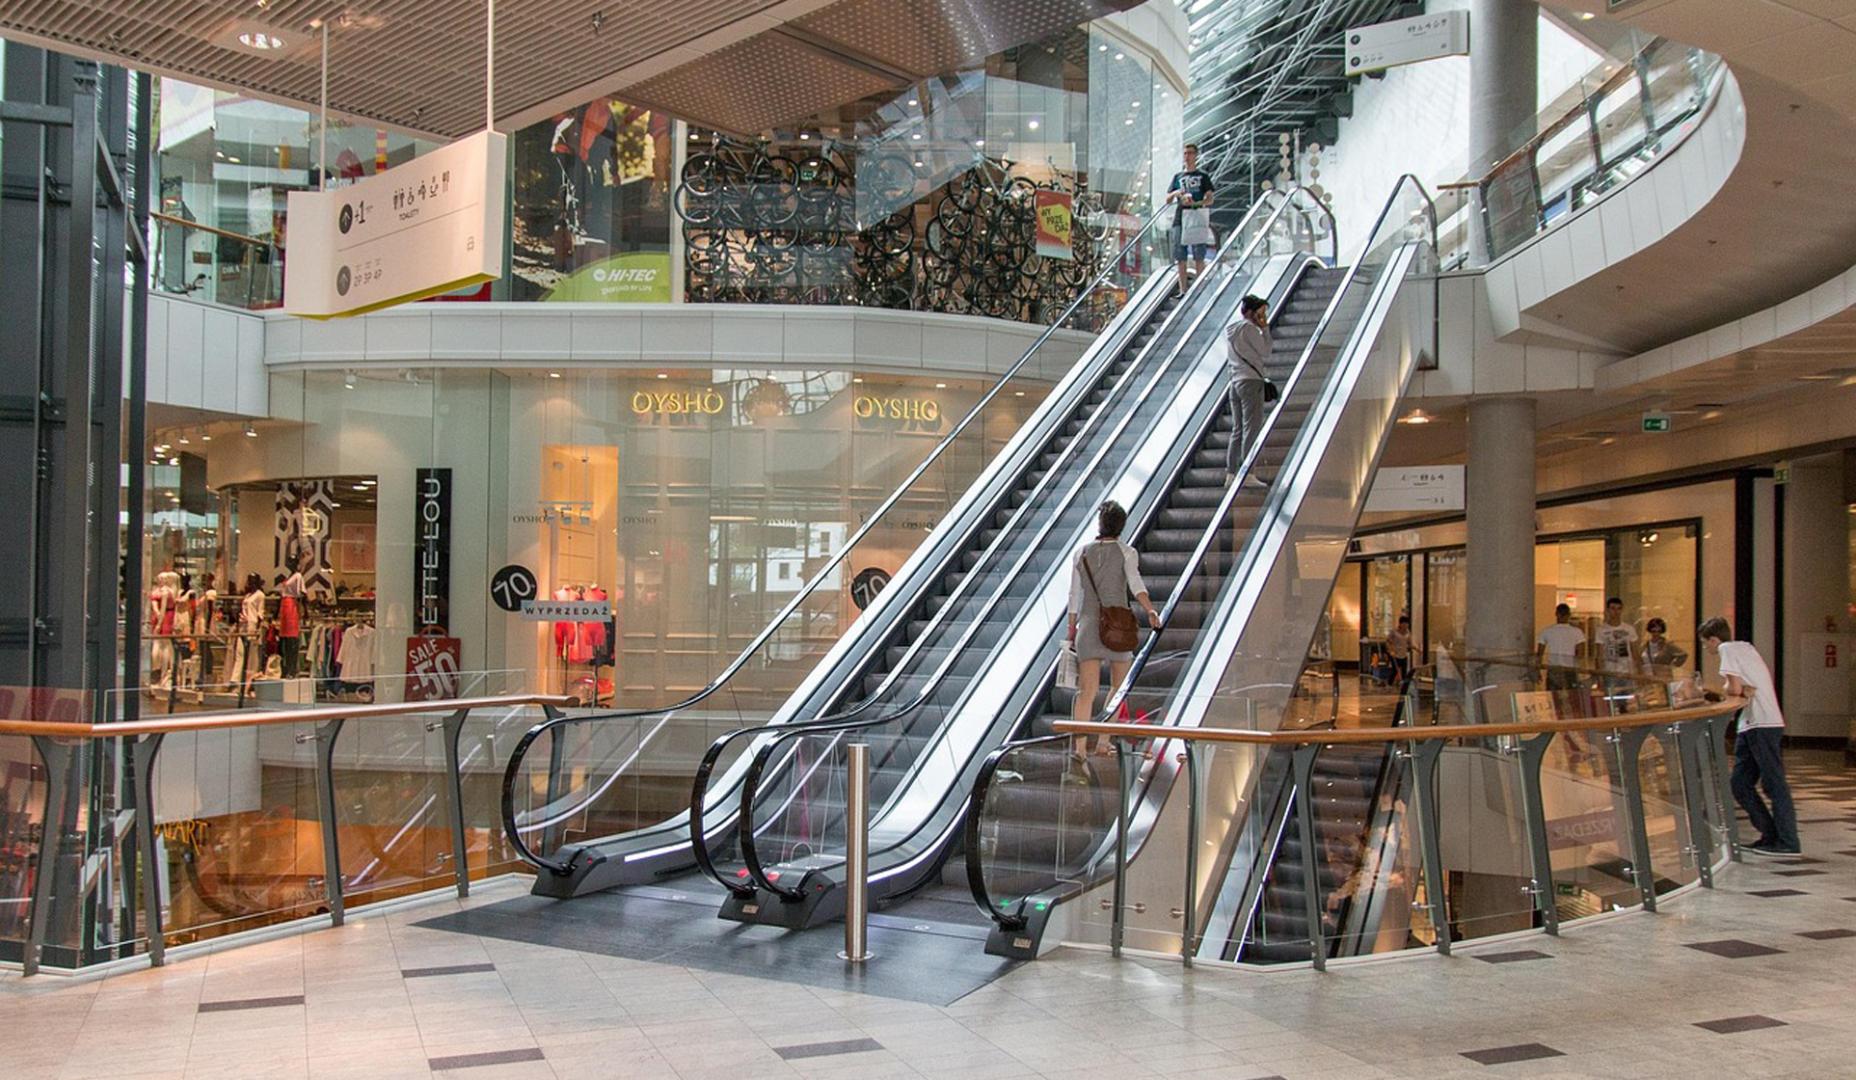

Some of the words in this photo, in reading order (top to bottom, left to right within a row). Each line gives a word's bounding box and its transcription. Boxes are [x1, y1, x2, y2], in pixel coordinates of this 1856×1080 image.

[632, 391, 724, 414] OYSHO
[853, 396, 938, 421] OYSHO
[409, 639, 440, 664] SALE
